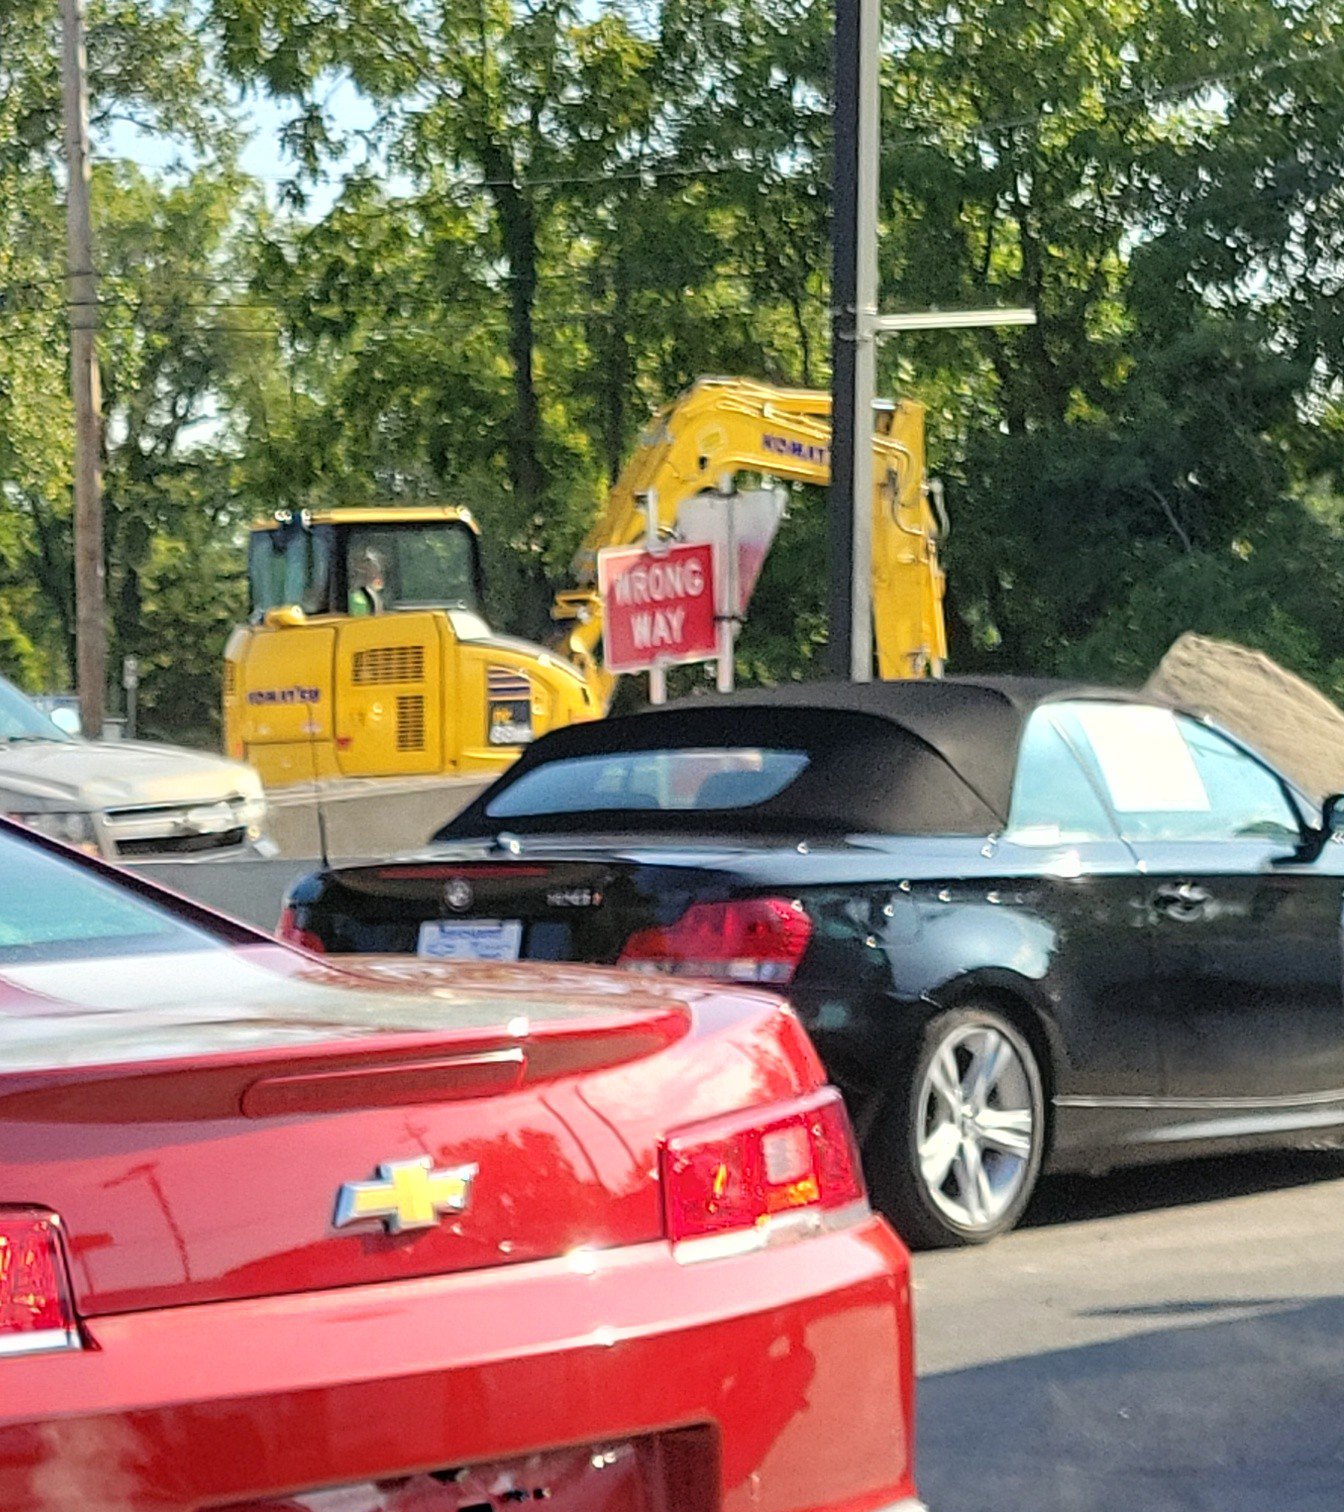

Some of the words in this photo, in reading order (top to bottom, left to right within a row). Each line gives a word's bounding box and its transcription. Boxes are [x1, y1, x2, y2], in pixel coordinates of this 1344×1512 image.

[763, 434, 825, 466] KOMAT
[615, 557, 705, 606] WRONG
[631, 605, 685, 650] WAY
